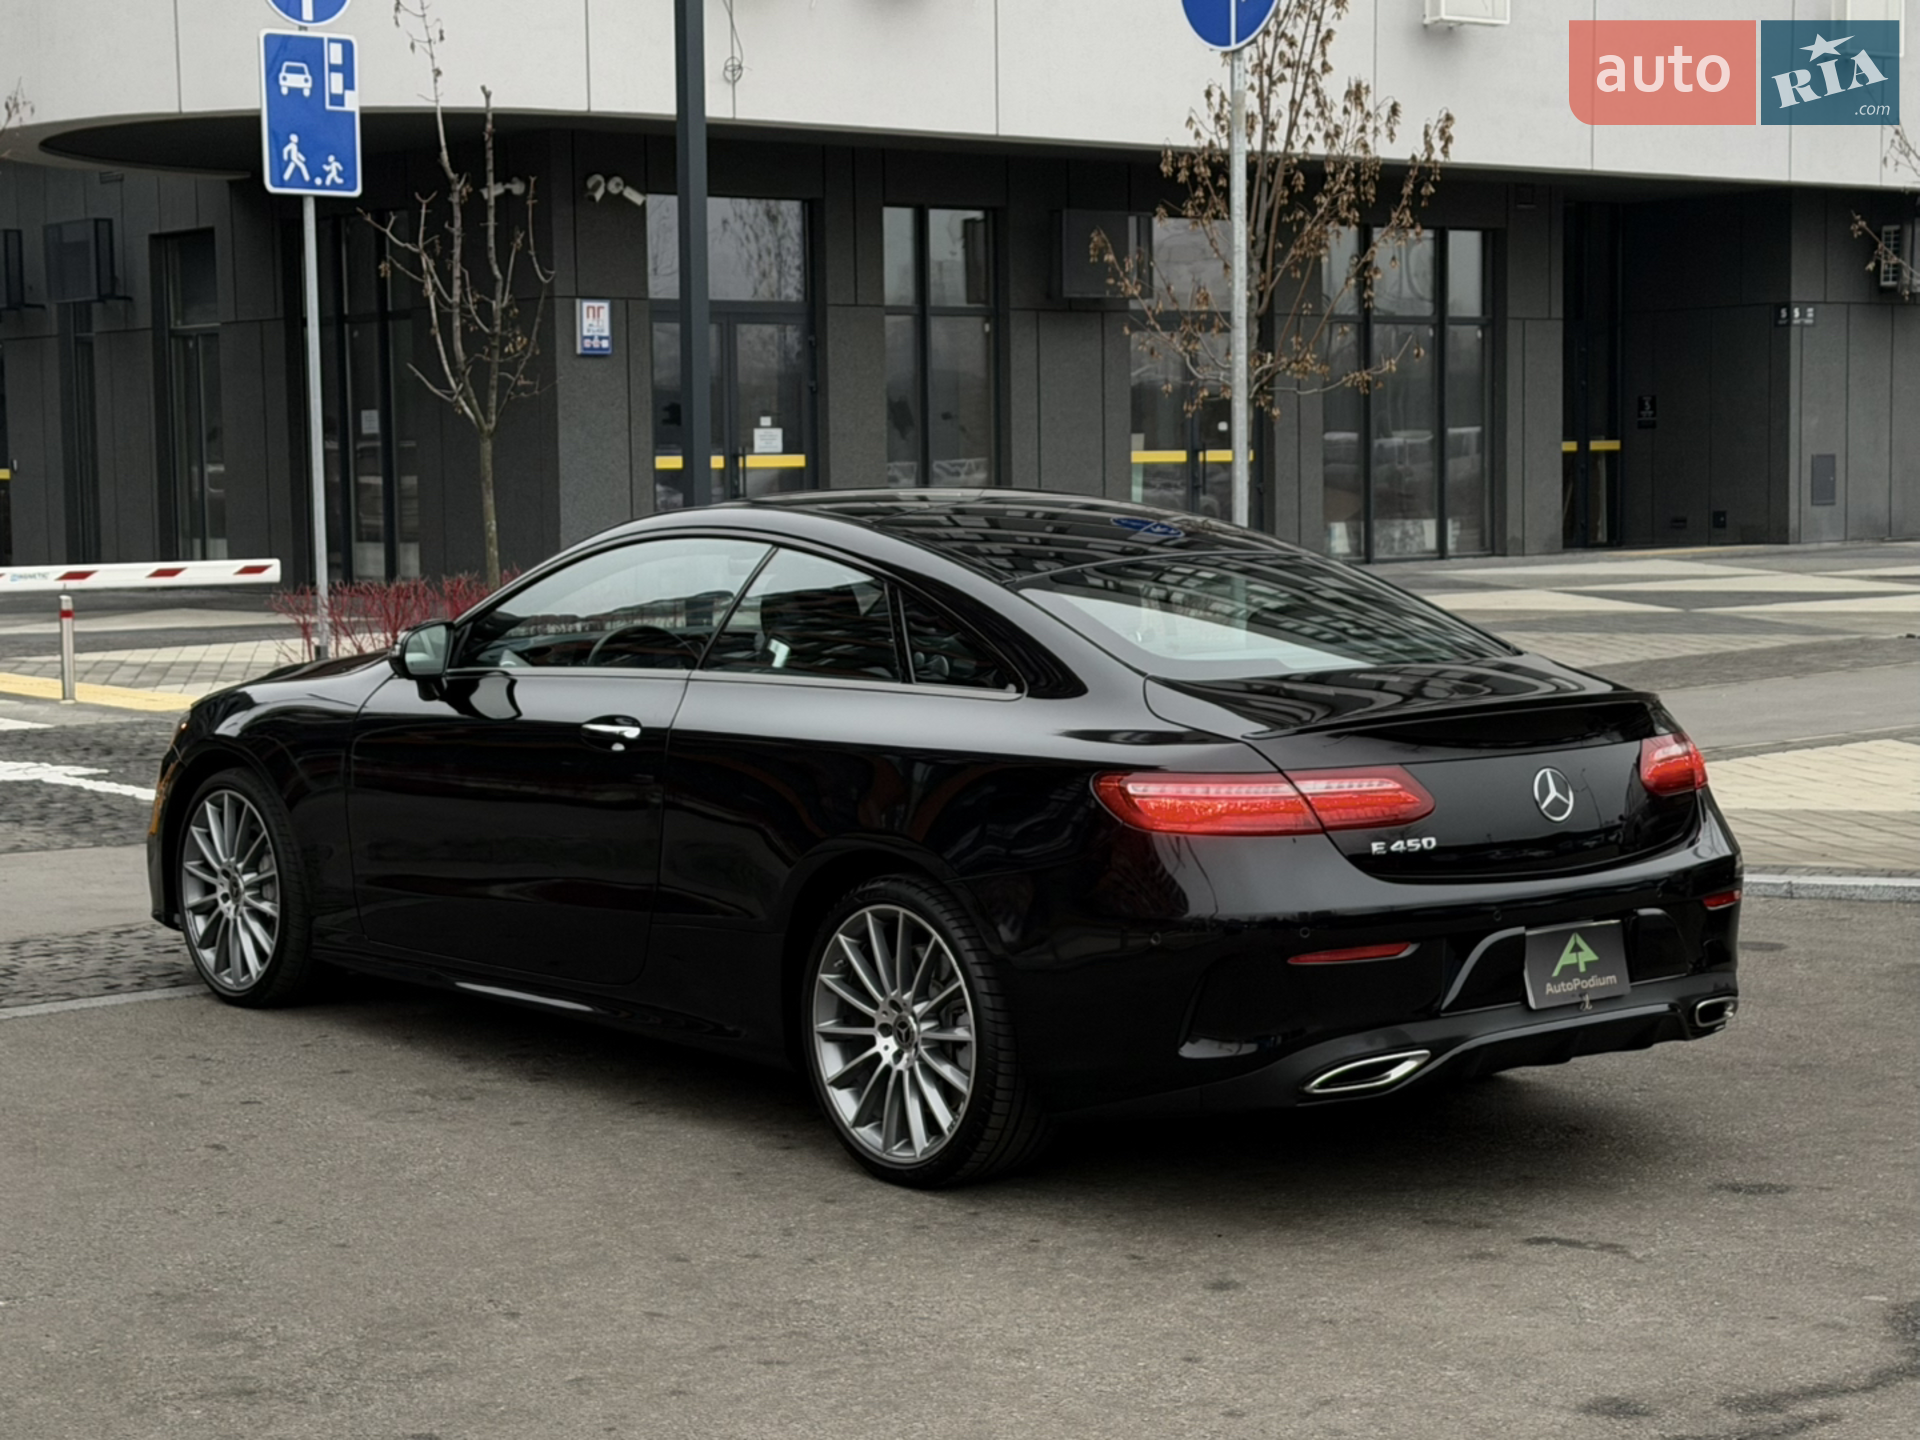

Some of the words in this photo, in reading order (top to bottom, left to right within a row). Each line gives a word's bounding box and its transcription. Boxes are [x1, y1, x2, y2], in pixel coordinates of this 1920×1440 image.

[1371, 841, 1387, 855] E
[1390, 837, 1437, 853] 450
[1545, 975, 1617, 995] AutoPodium
